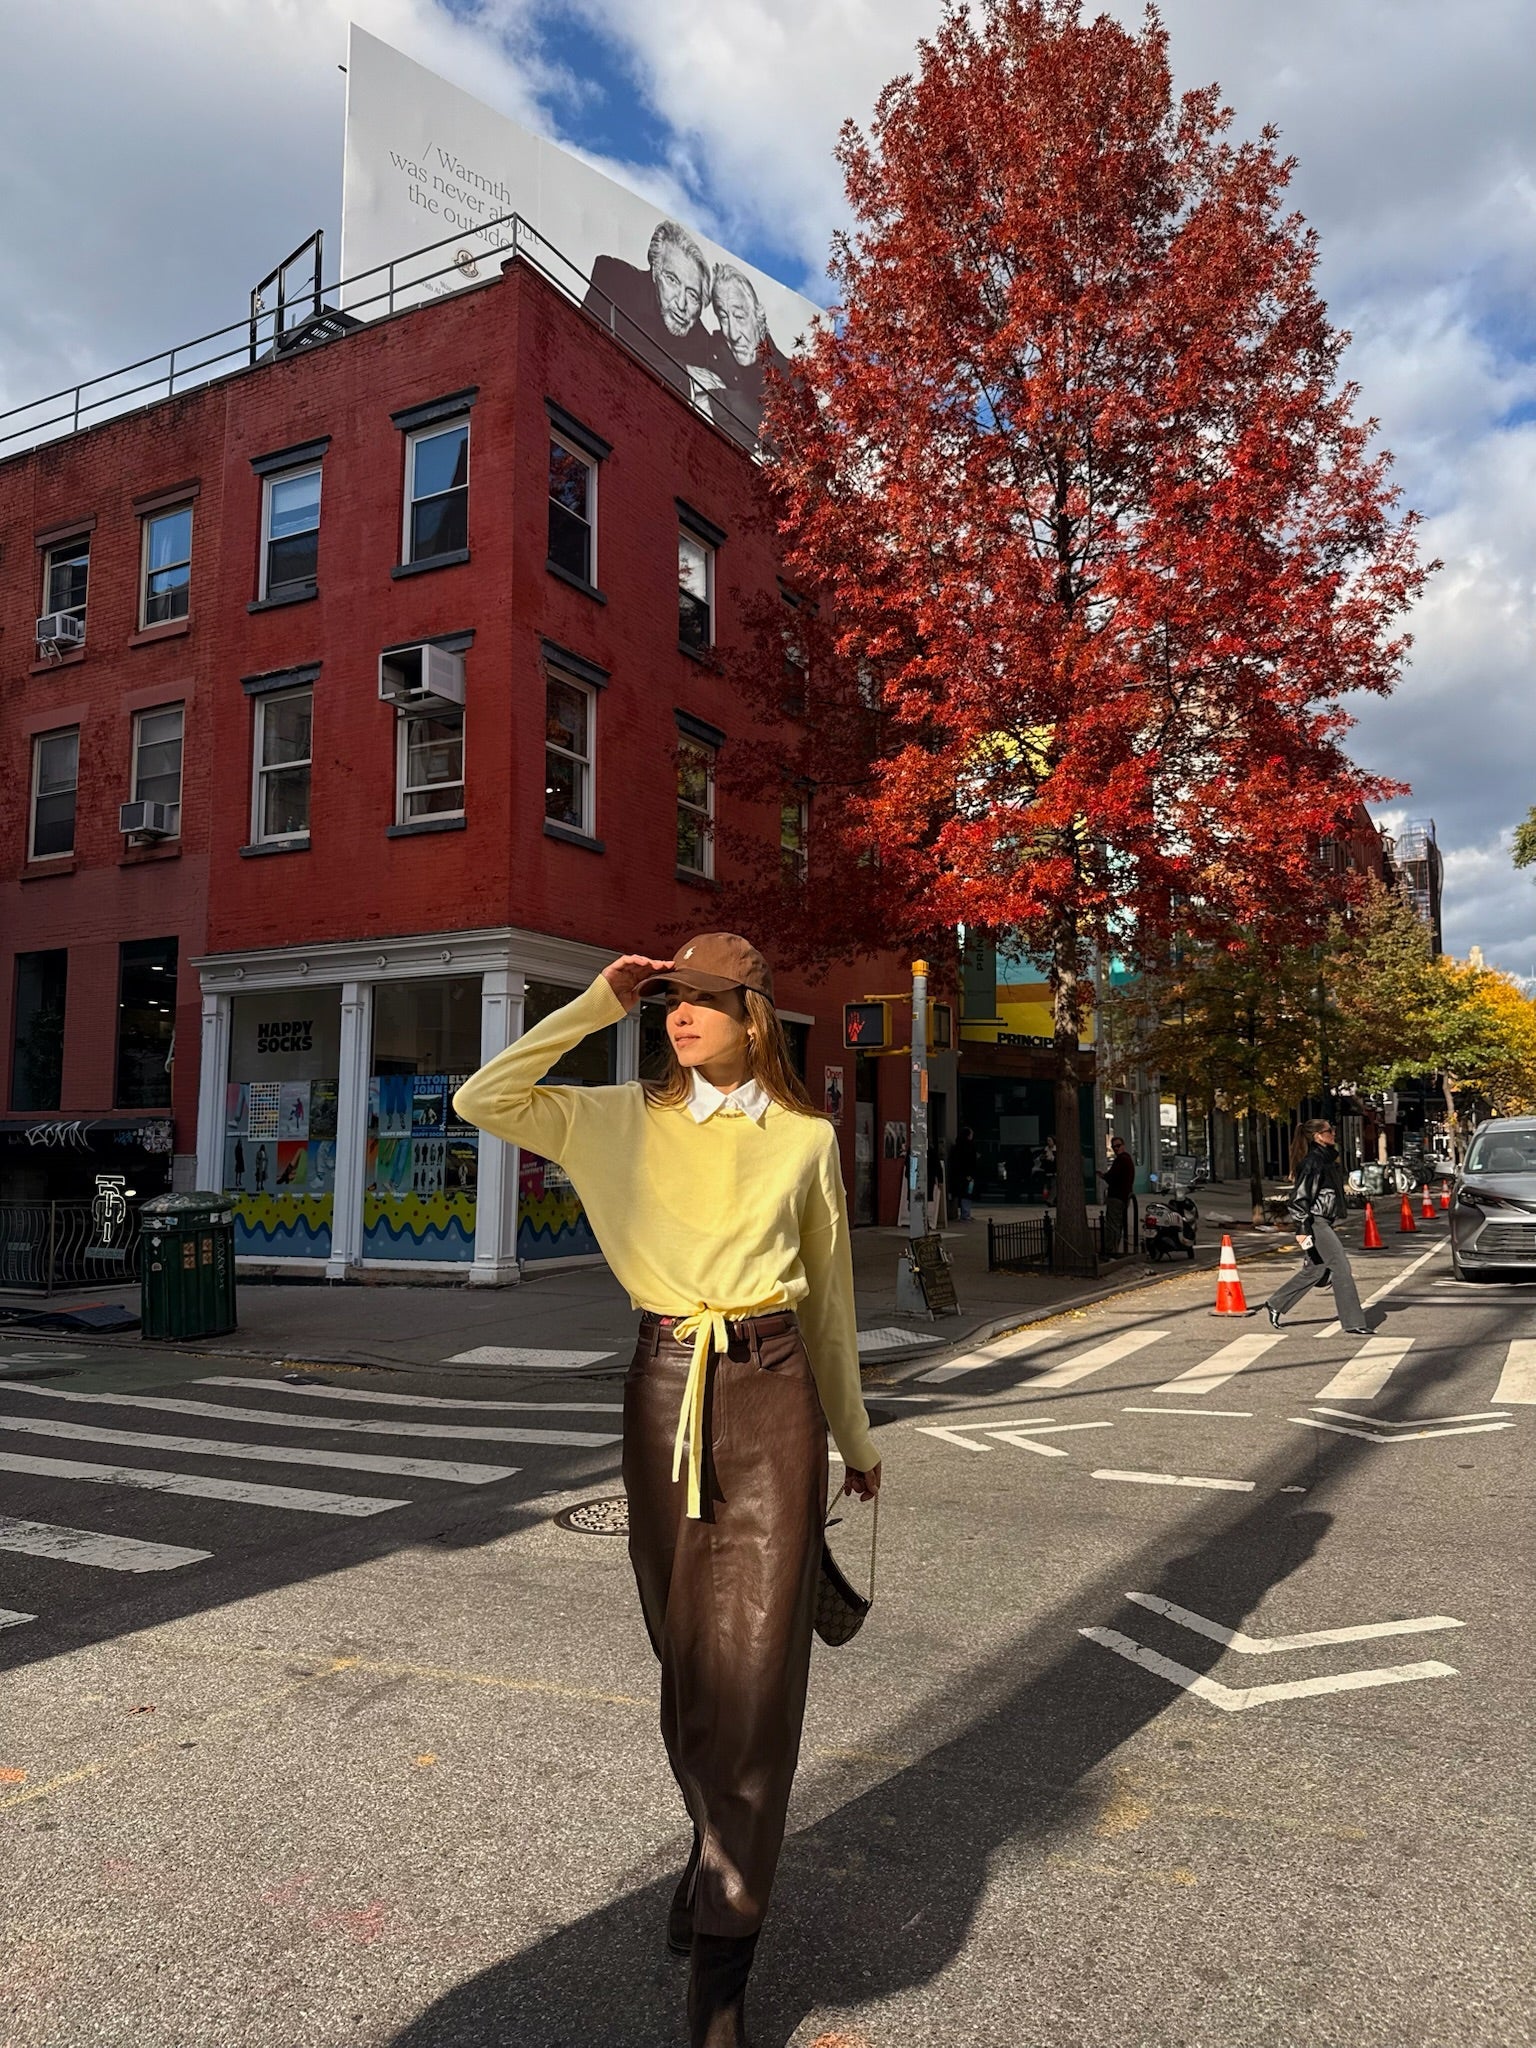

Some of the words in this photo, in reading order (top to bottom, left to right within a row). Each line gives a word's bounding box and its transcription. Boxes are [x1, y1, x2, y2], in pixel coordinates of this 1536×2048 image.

[389, 150, 428, 184] was
[433, 175, 485, 214] never
[436, 147, 512, 206] Warmth
[408, 183, 440, 215] the
[257, 1020, 313, 1038] HAPPY
[257, 1036, 313, 1053] SOCKS
[413, 1075, 448, 1085] ELTON
[448, 1075, 473, 1085] ELT
[413, 1084, 442, 1095] JOHN
